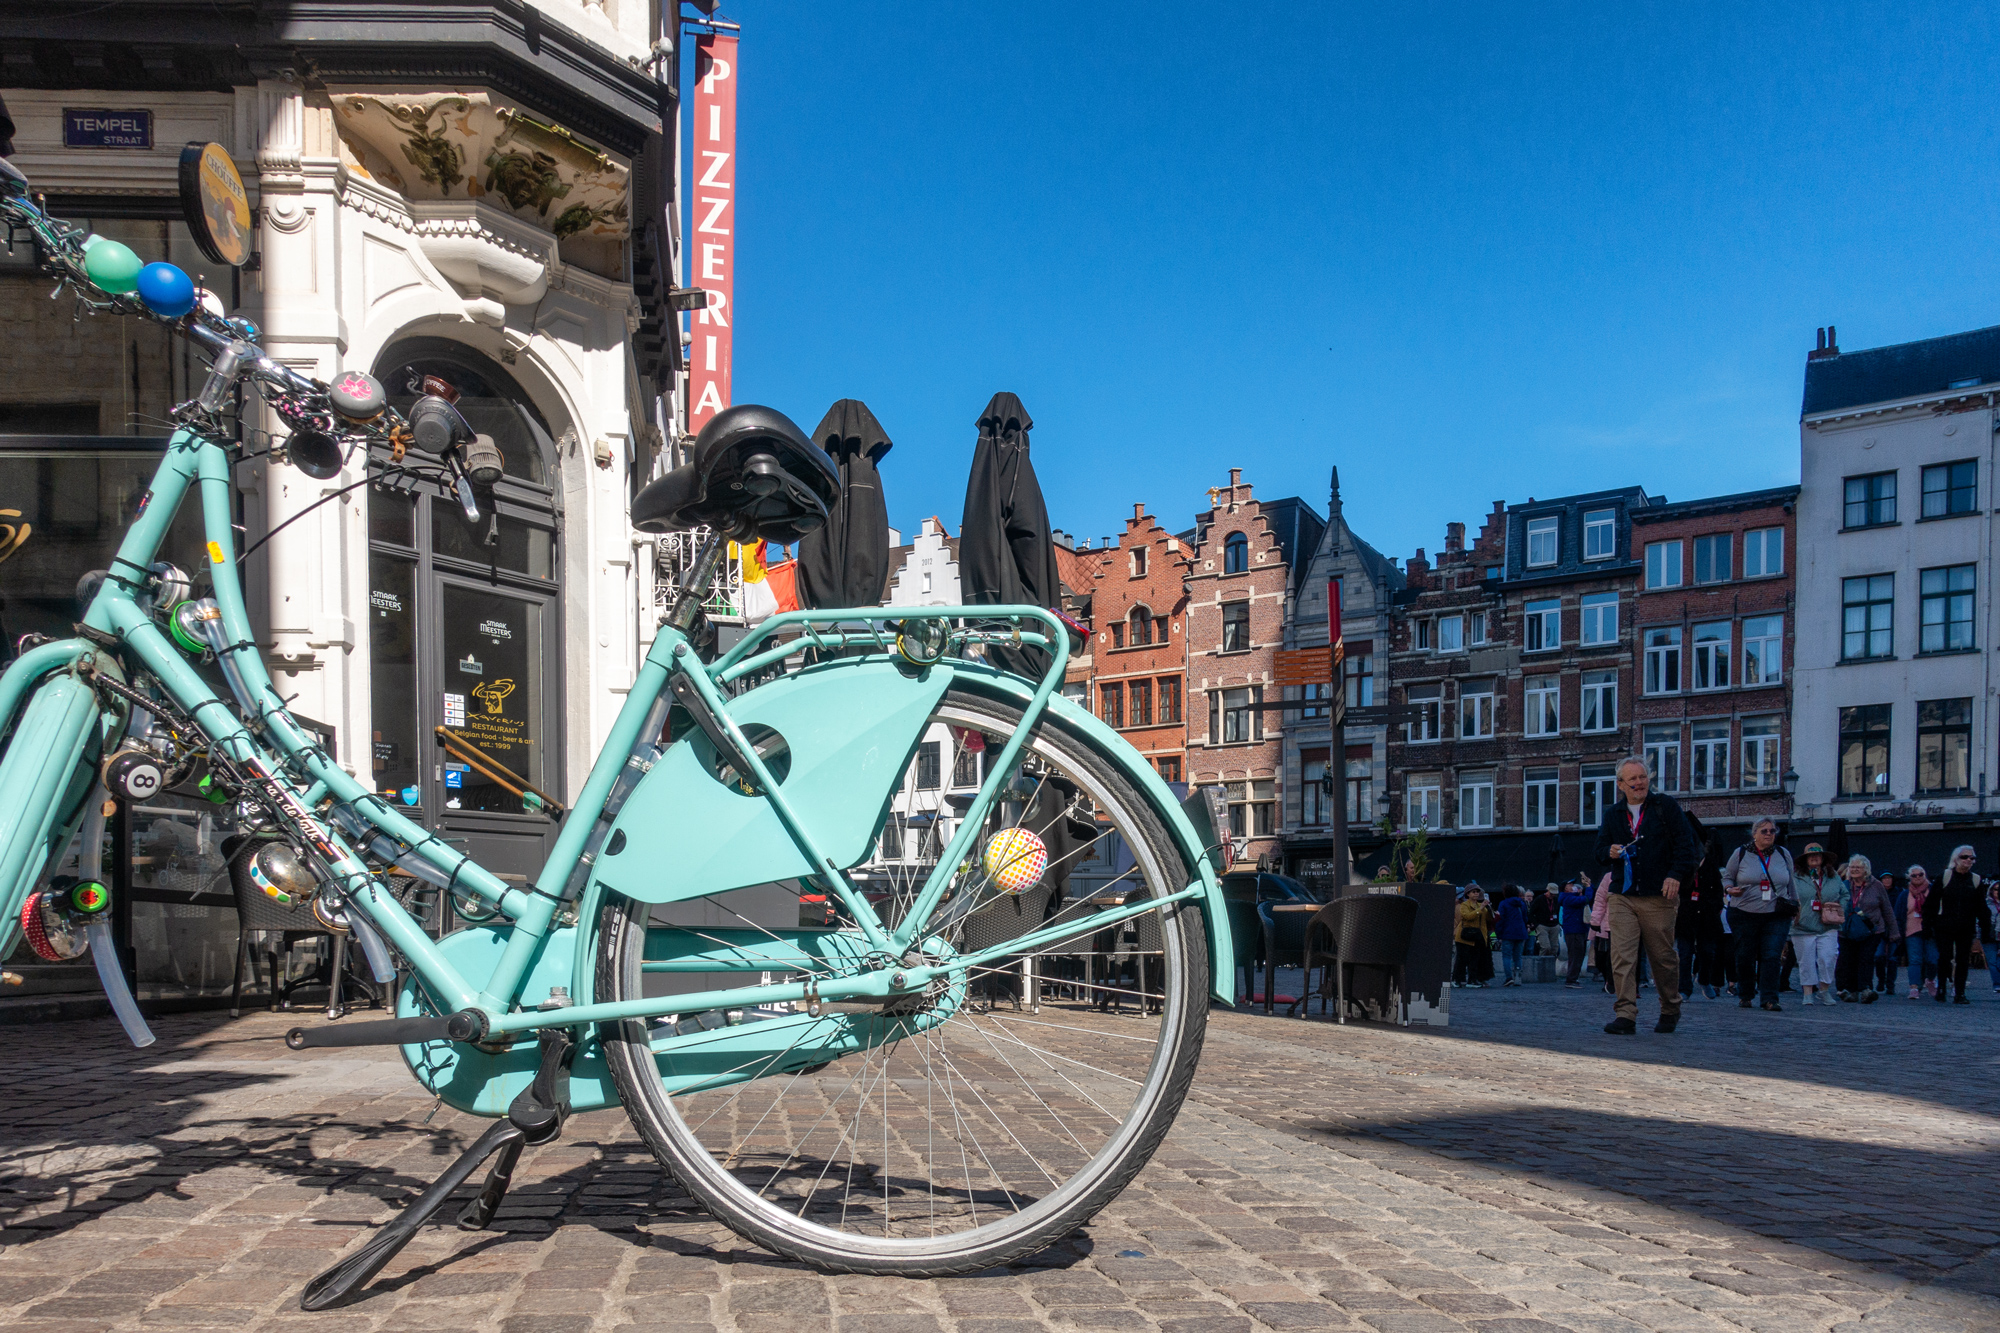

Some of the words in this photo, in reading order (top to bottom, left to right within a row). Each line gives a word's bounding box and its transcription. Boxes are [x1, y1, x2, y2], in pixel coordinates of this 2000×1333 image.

[73, 118, 142, 132] TEMPEL
[103, 135, 142, 145] STRAAT
[206, 153, 243, 199] CHOUFFE
[693, 57, 731, 415] PIZZERIA
[372, 590, 398, 602] SMAAK
[479, 622, 512, 639] MEESTERS
[486, 619, 508, 630] SMAAK
[472, 722, 518, 734] RESTAURANT
[454, 729, 481, 738] Belgian
[482, 732, 497, 741] food
[502, 736, 517, 744] beer
[494, 742, 511, 750] 1999
[133, 773, 156, 789] 8
[1926, 802, 1944, 814] bier
[1310, 862, 1334, 870] Sint-Ja
